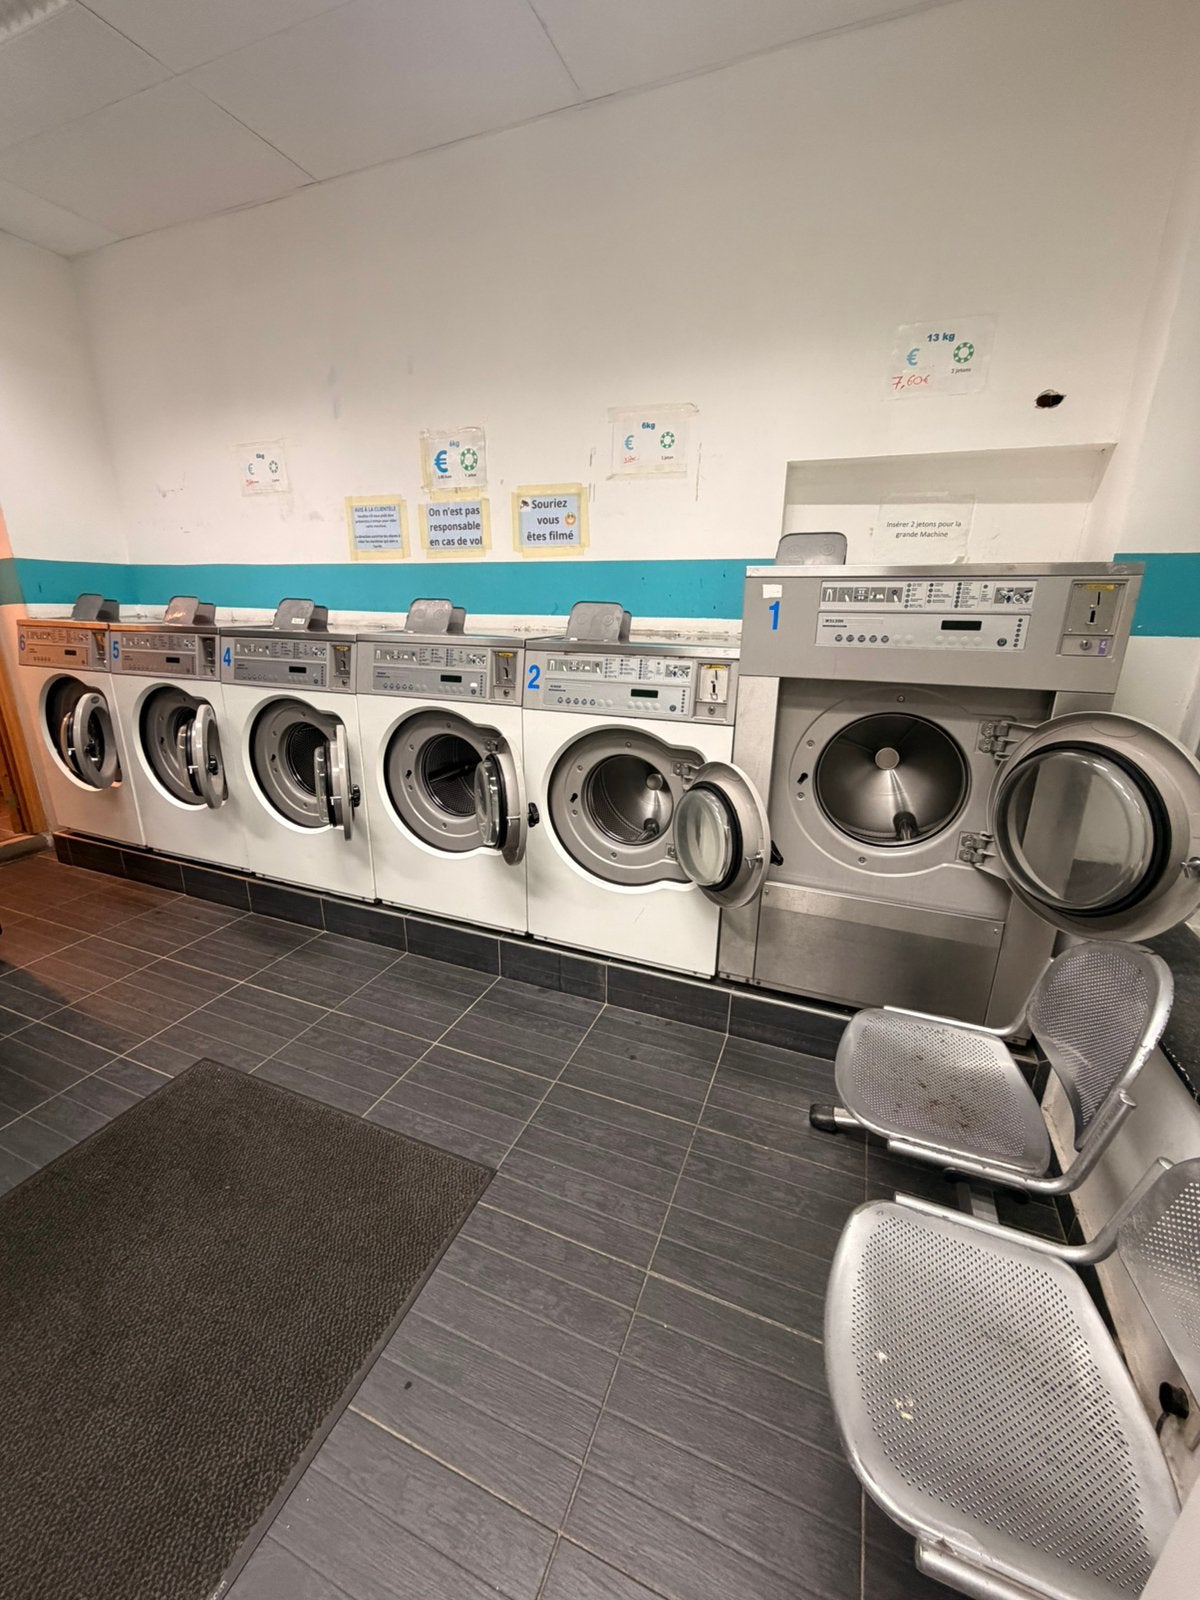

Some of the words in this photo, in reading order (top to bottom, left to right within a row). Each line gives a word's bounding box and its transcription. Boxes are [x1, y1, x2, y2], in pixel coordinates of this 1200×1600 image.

[927, 333, 940, 342] 13
[942, 332, 956, 342] kg
[906, 348, 920, 366] €
[641, 422, 656, 431] 6kg
[433, 450, 449, 473] €
[531, 498, 568, 509] Souriez
[428, 508, 441, 517] On
[442, 507, 463, 516] n'est
[465, 507, 481, 518] pas
[537, 516, 560, 525] vous
[915, 521, 937, 529] jetons
[938, 521, 954, 529] pour
[430, 520, 481, 533] responsable
[526, 531, 547, 541] êtes
[549, 530, 574, 541] filmé
[895, 531, 918, 539] grande
[429, 539, 440, 547] en
[441, 538, 456, 546] cas
[456, 536, 468, 546] de
[469, 536, 483, 545] vol
[768, 600, 780, 631] 1
[19, 634, 26, 651] 6
[112, 641, 120, 659] 5
[223, 647, 232, 667] 4
[527, 664, 541, 690] 2
